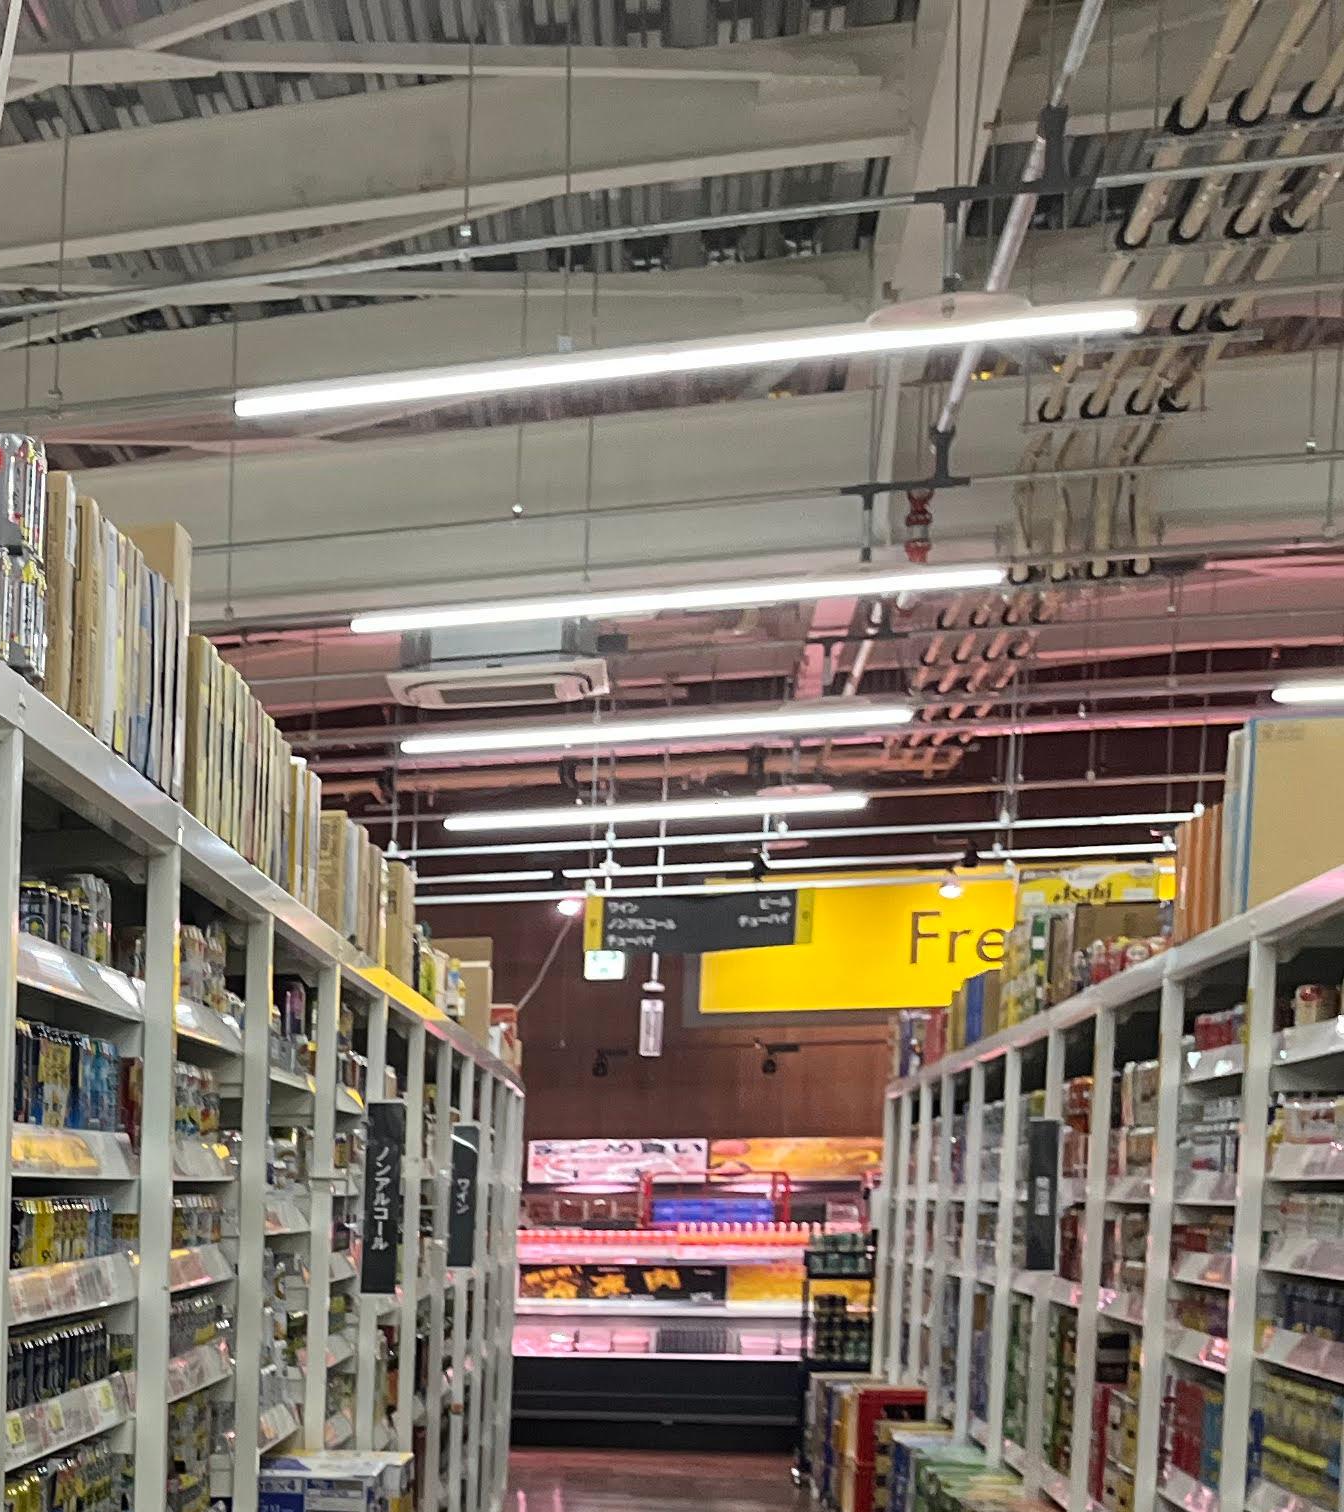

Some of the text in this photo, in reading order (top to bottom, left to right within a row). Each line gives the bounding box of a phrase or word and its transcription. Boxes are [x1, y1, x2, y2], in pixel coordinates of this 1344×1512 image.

[370, 1146, 392, 1250] ノンアルコール
[456, 1178, 470, 1215] ワイン
